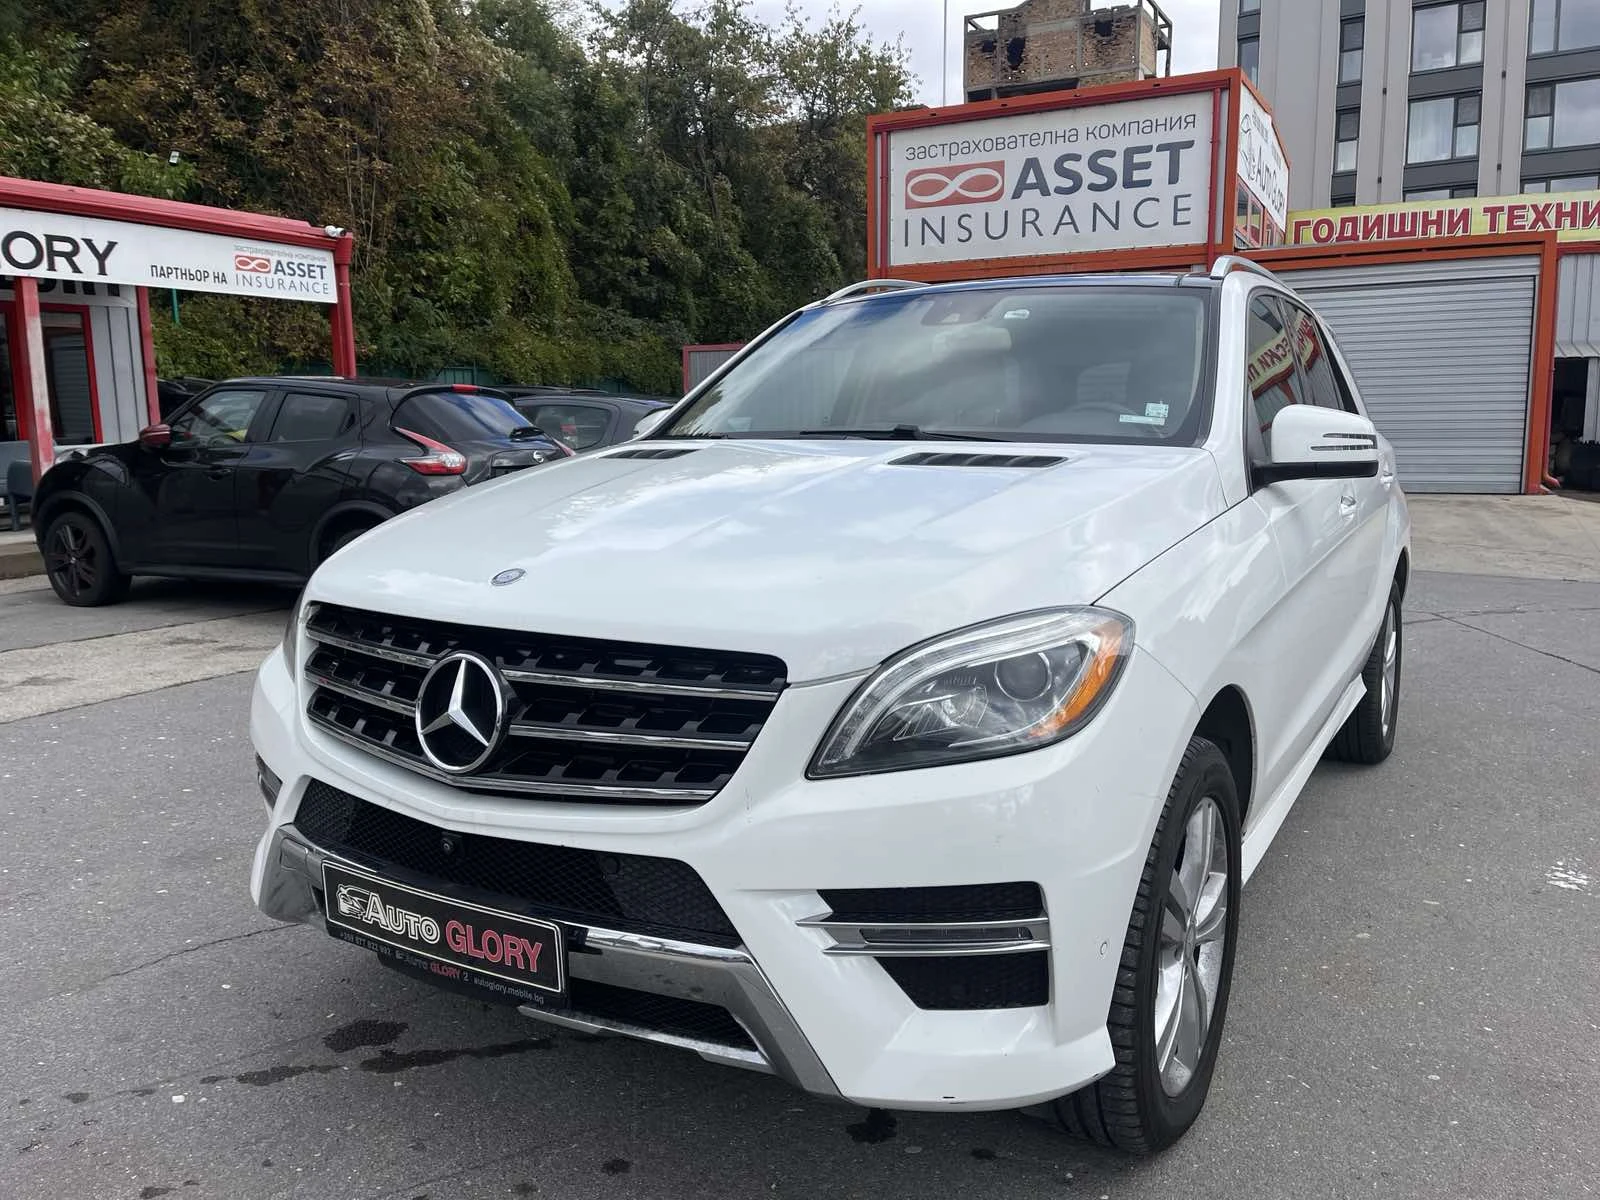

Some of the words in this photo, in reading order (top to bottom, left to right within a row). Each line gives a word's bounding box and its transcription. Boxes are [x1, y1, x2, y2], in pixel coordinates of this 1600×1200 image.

[904, 125, 1079, 161] застрахователна
[1085, 113, 1197, 141] компания
[1011, 139, 1196, 200] ASSET
[904, 193, 1193, 248] INSURANCE
[1292, 206, 1471, 243] ГОДИШНИ
[1483, 199, 1600, 233] ТЕХНИ
[0, 230, 118, 276] ORY
[150, 265, 210, 284] ПАРТНЬОР
[213, 271, 228, 285] НА
[274, 259, 327, 280] ASSET
[235, 273, 329, 295] INSURANCE
[445, 920, 542, 973] GLORY
